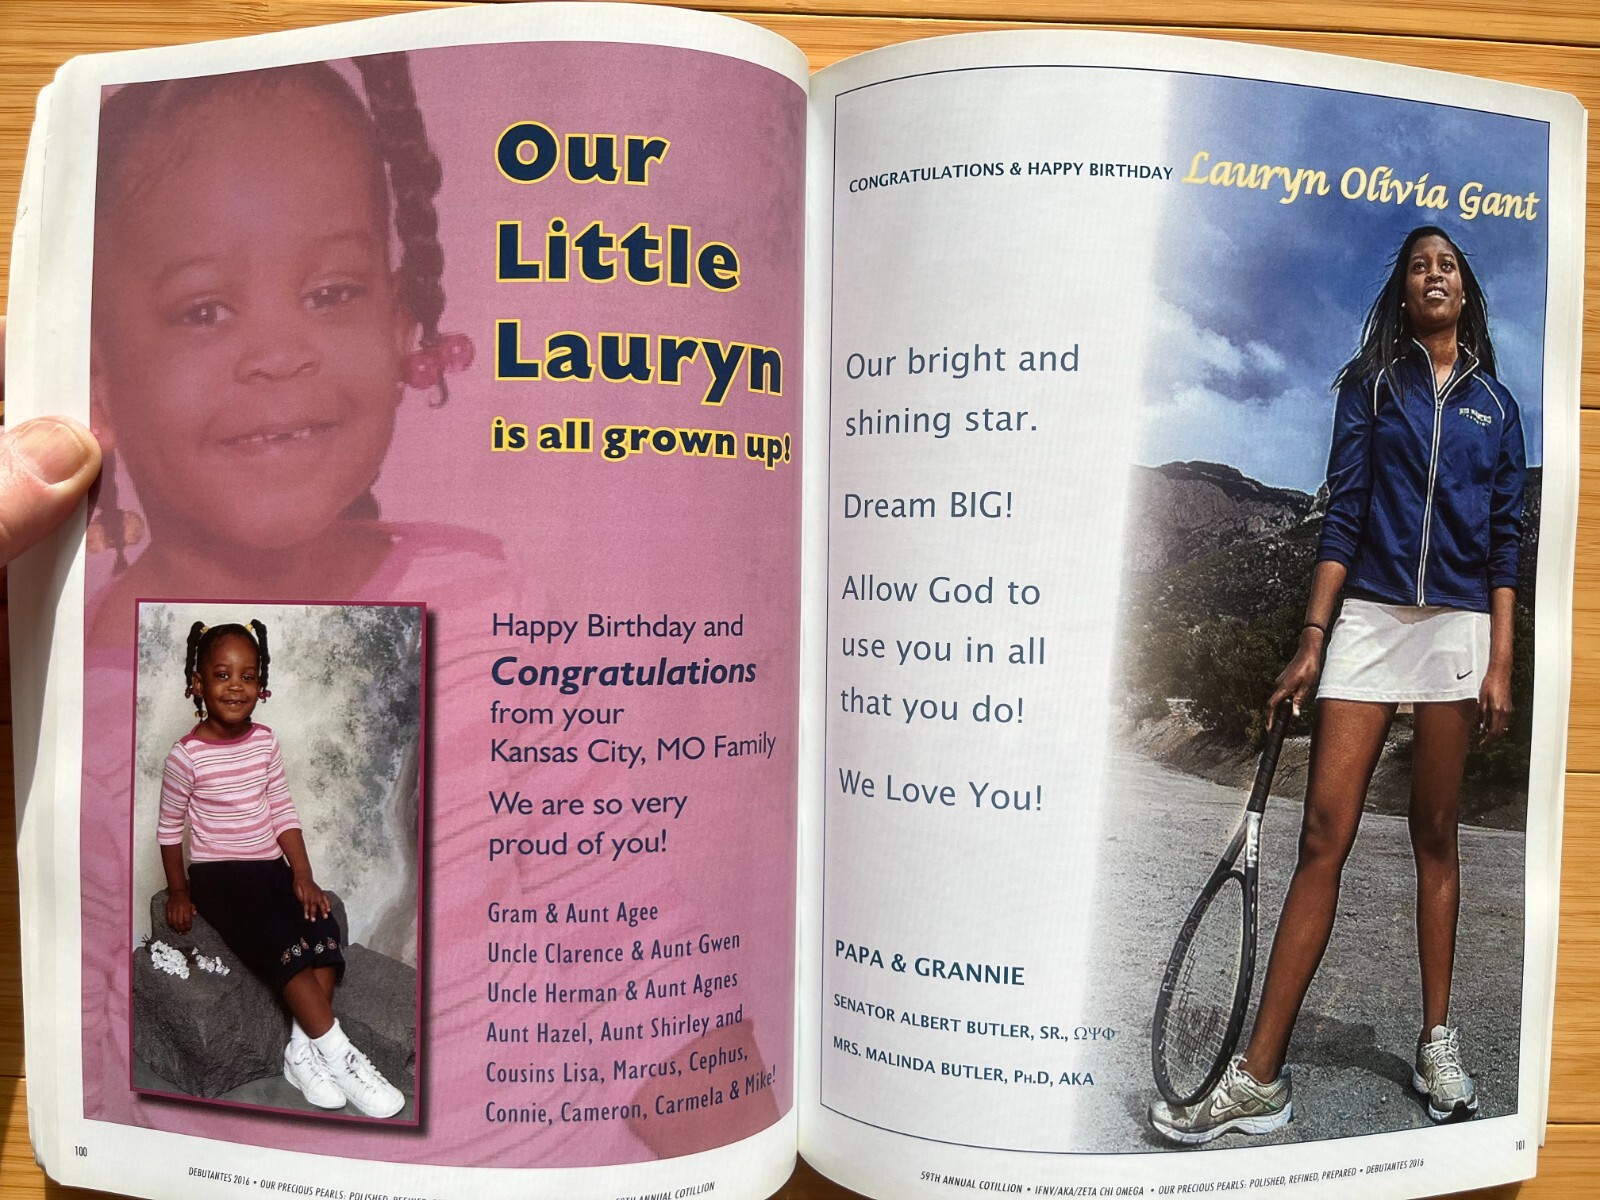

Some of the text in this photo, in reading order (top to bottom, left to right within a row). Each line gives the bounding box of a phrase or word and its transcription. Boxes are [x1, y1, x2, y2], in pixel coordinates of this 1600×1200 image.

[495, 120, 671, 186] Our
[849, 151, 1541, 221] CONGRATULATIONS & HAPPY BIRTHDAY Lauryn Olivia Gant
[496, 216, 741, 292] Little
[495, 318, 783, 406] Lauryn
[846, 343, 1079, 379] Our bright and
[845, 407, 1037, 438] shining star.
[492, 416, 792, 470] is all grown up!
[844, 491, 1012, 519] Dream BIG!
[841, 574, 1041, 605] Allow God to
[492, 612, 743, 644] Happy Birthday and
[842, 636, 1045, 665] use you in all
[491, 656, 757, 695] Congratulations
[490, 700, 624, 731] from your
[840, 686, 1023, 724] that you do!
[490, 731, 776, 769] Kansas City, MO Family
[488, 791, 688, 819] We are so very
[838, 767, 1042, 811] We Love You!
[489, 829, 667, 861] proud of you!
[488, 902, 658, 928] Gram & Aunt Agee
[488, 934, 740, 963] Uncle Clarence & Aunt Gwen
[835, 939, 1025, 986] PAPA & GRANNIE
[488, 972, 738, 1003] Uncle Herman & Aunt Agnes
[486, 1003, 743, 1045] Aunt Hazel, Aunt Shirley and
[834, 993, 1116, 1042] SENATOR ALBERT BUTLER, SR., ΩΨΦ
[486, 1046, 748, 1085] Cousins Lisa, Marcus, Cephus,
[833, 1036, 862, 1057] MRS.
[865, 1046, 936, 1074] MALINDA
[941, 1062, 1008, 1084] BUTLER,
[1058, 1072, 1095, 1086] AKA
[486, 1065, 777, 1125] Connie, Cameron, Carmela & Mike!
[74, 1146, 88, 1158] 100
[1516, 1140, 1525, 1151] 101
[189, 1166, 232, 1183] DEBUTANTES
[233, 1175, 250, 1186] 2016
[260, 1179, 276, 1190] OUR
[277, 1182, 314, 1196] PRECIOUS
[315, 1187, 346, 1200] PEARLS:
[675, 1181, 715, 1199] COTILLION
[920, 1157, 1425, 1196] 59TH ANNUAL COTILLION IFNV/AKA/ZETA CHI OMEGA OUR PRECIOUS PEARLS: POLISHED, REFINED, PREPARED DEBUTANTES 2016
